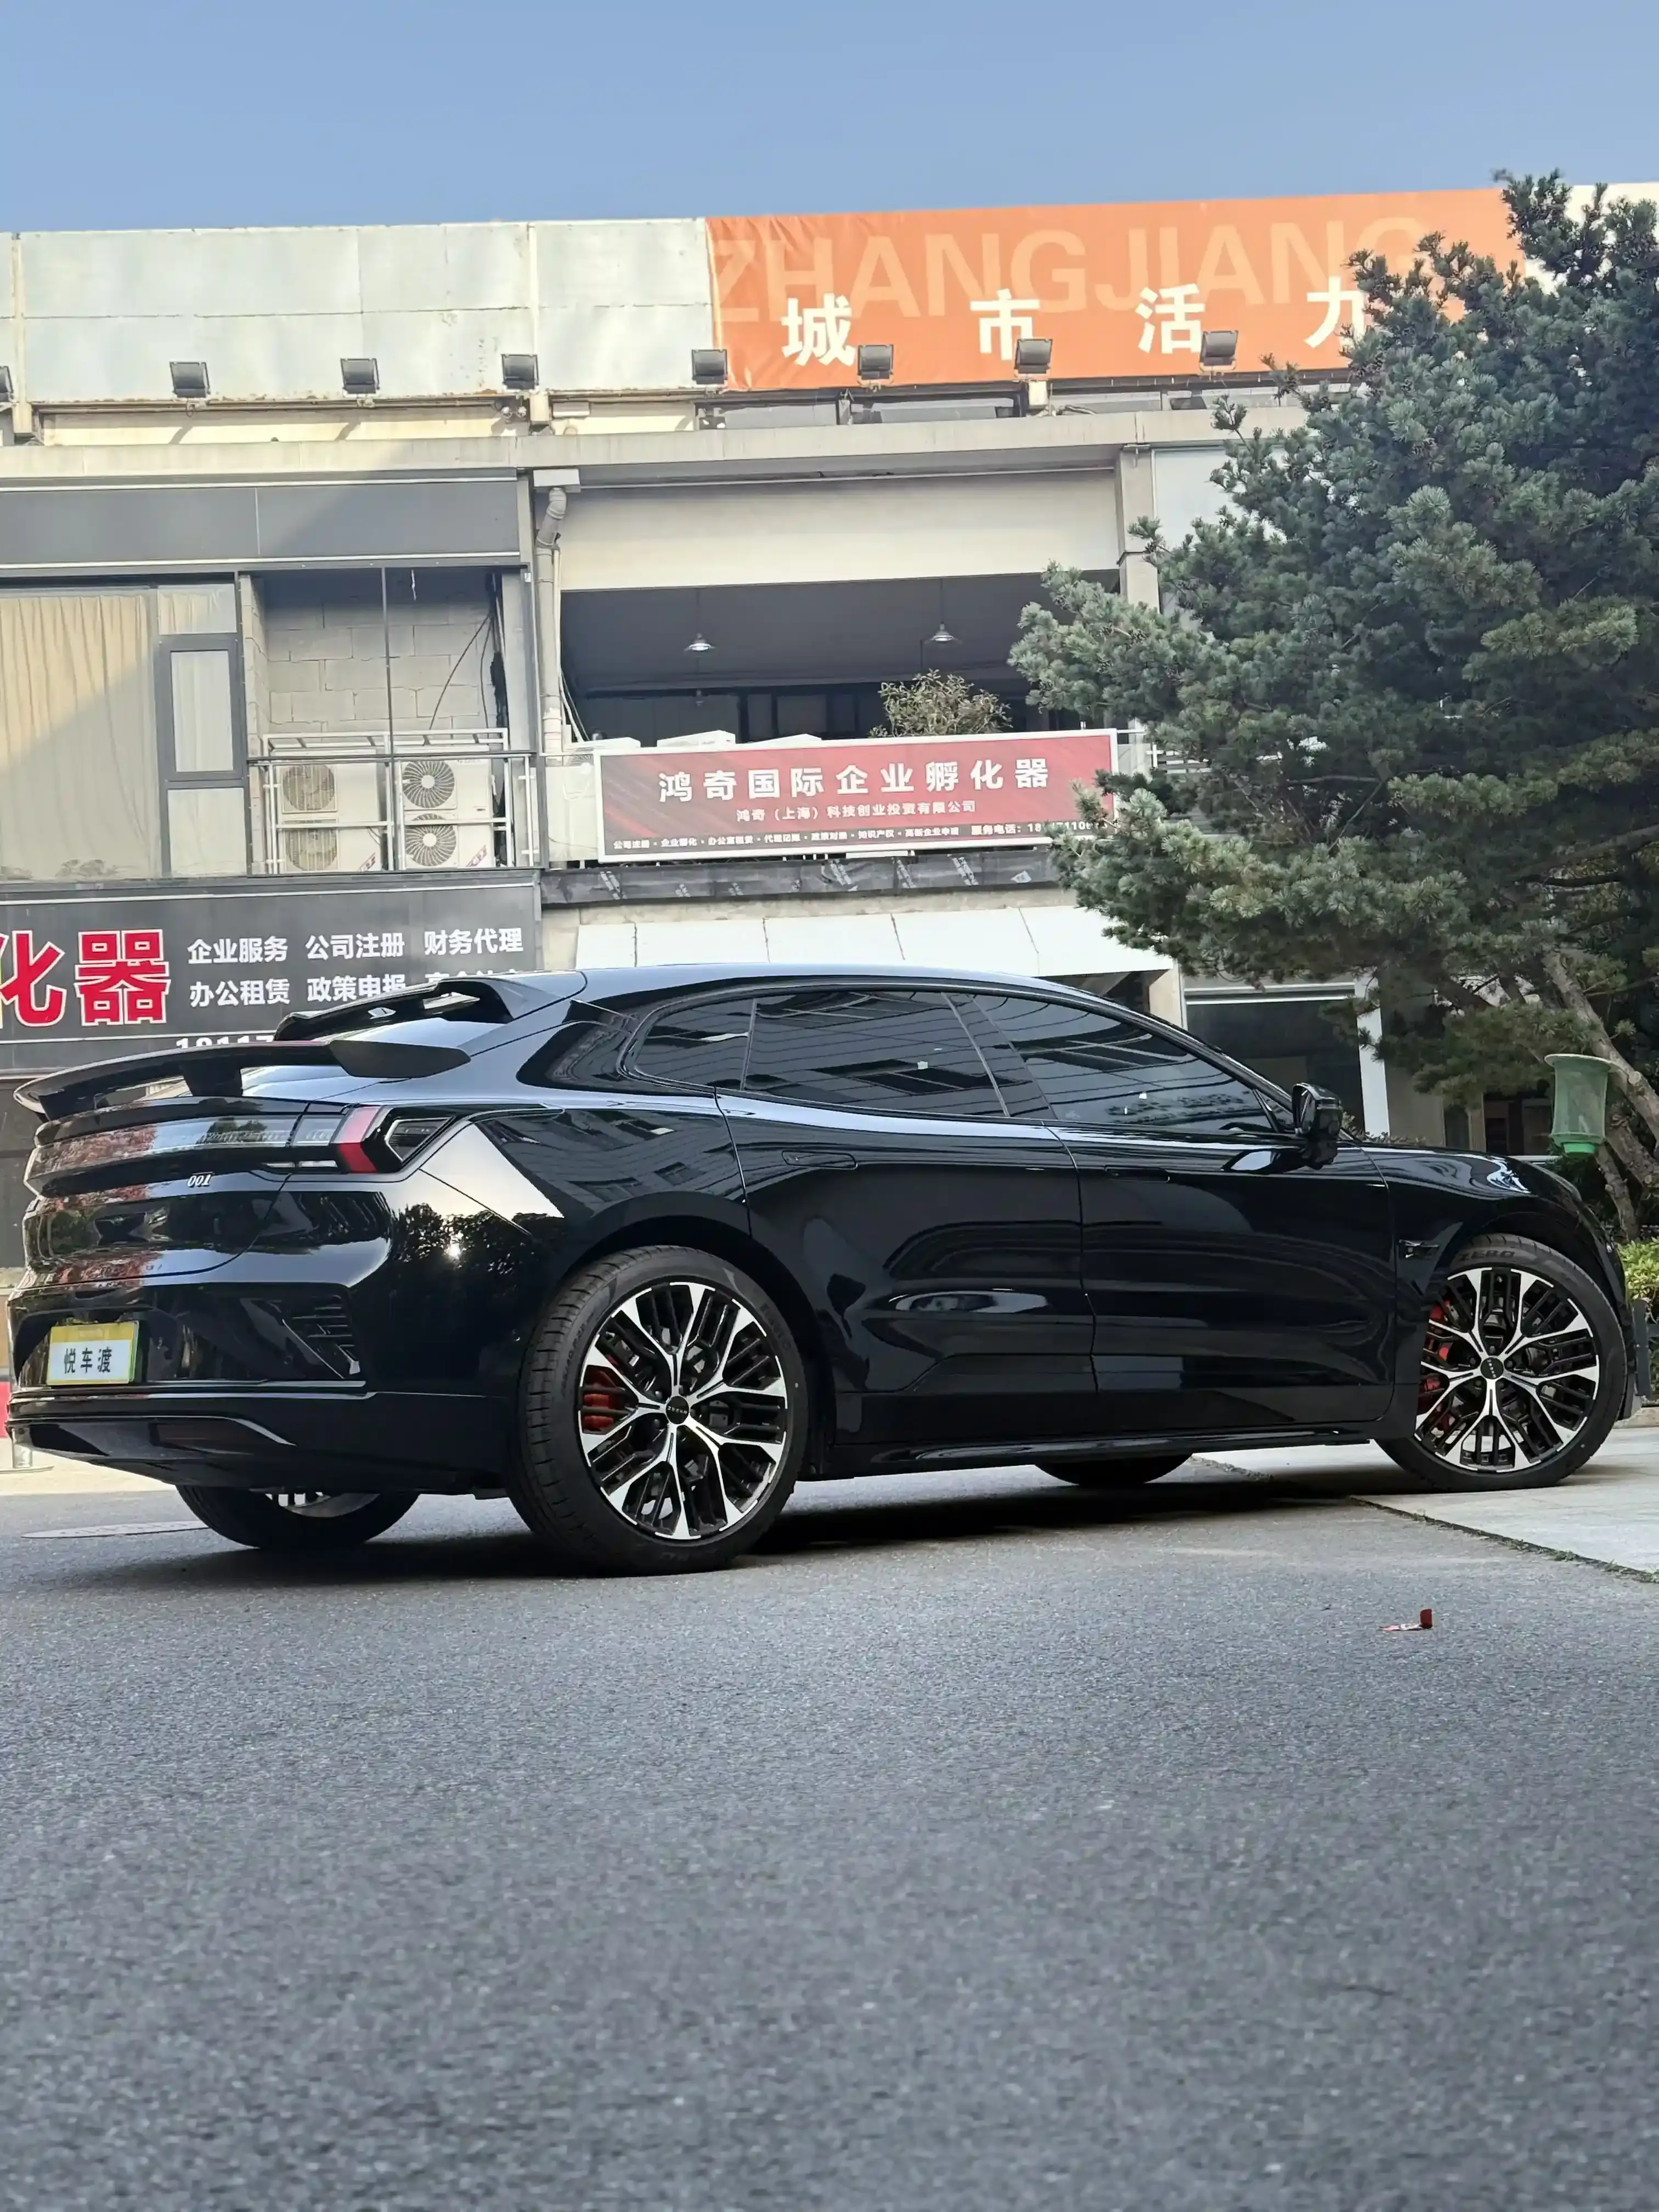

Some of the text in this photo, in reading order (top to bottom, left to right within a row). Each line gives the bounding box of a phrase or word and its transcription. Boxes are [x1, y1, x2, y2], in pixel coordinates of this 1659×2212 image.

[658, 758, 1049, 803] 鸿奇国际企业孵化器
[187, 927, 524, 964] 企业服务 公司注册 财务代理
[189, 978, 290, 1007] 办公租赁
[307, 973, 406, 1002] 政策申报
[187, 1174, 211, 1187] 001
[64, 1346, 112, 1374] 悦车渡
